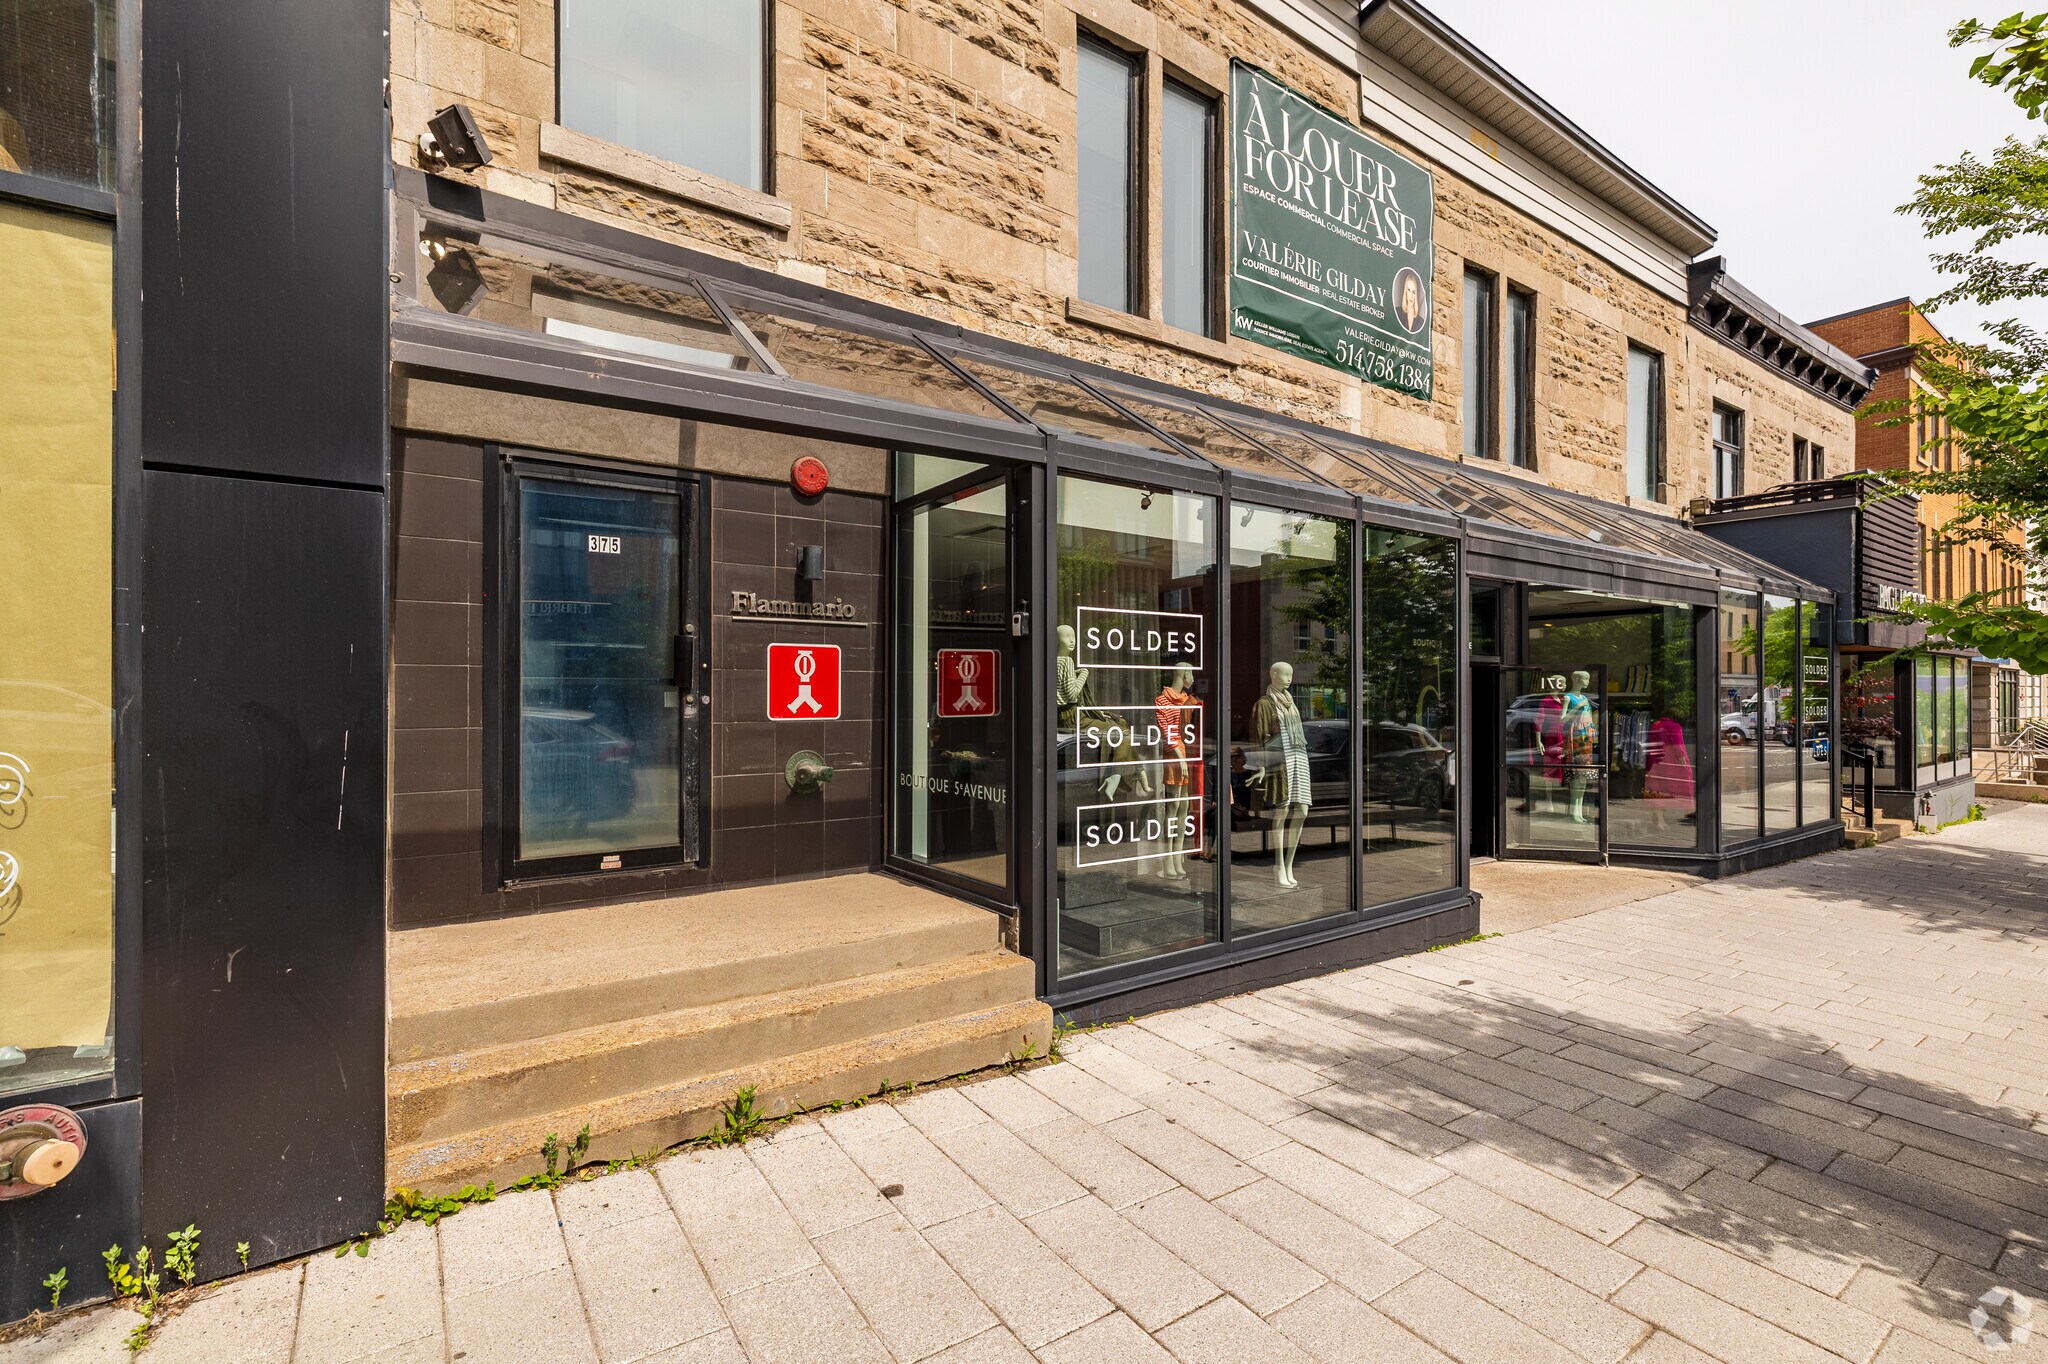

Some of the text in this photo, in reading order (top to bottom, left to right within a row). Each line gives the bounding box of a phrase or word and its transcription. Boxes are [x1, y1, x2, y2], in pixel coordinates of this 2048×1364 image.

[1243, 78, 1401, 211] À LOUER
[1243, 134, 1418, 255] FOR LEASE
[1243, 183, 1394, 258] ESPACE COMMERCIAL COMMERCIAL SPACE
[1243, 230, 1386, 307] VALÉRIE GILDAY
[1242, 257, 1385, 320] COURTIER IMMOBILIER REAL ESTATE BROKER
[1335, 339, 1431, 394] 514.758.1384
[590, 536, 619, 553] 375
[1087, 627, 1196, 653] SOLDES
[1805, 664, 1827, 675] SOLDES
[1805, 706, 1827, 716] SOLDES
[1087, 724, 1196, 749] SOLDES
[900, 773, 949, 793] BOUTIQUE
[1087, 815, 1196, 848] SOLDES
